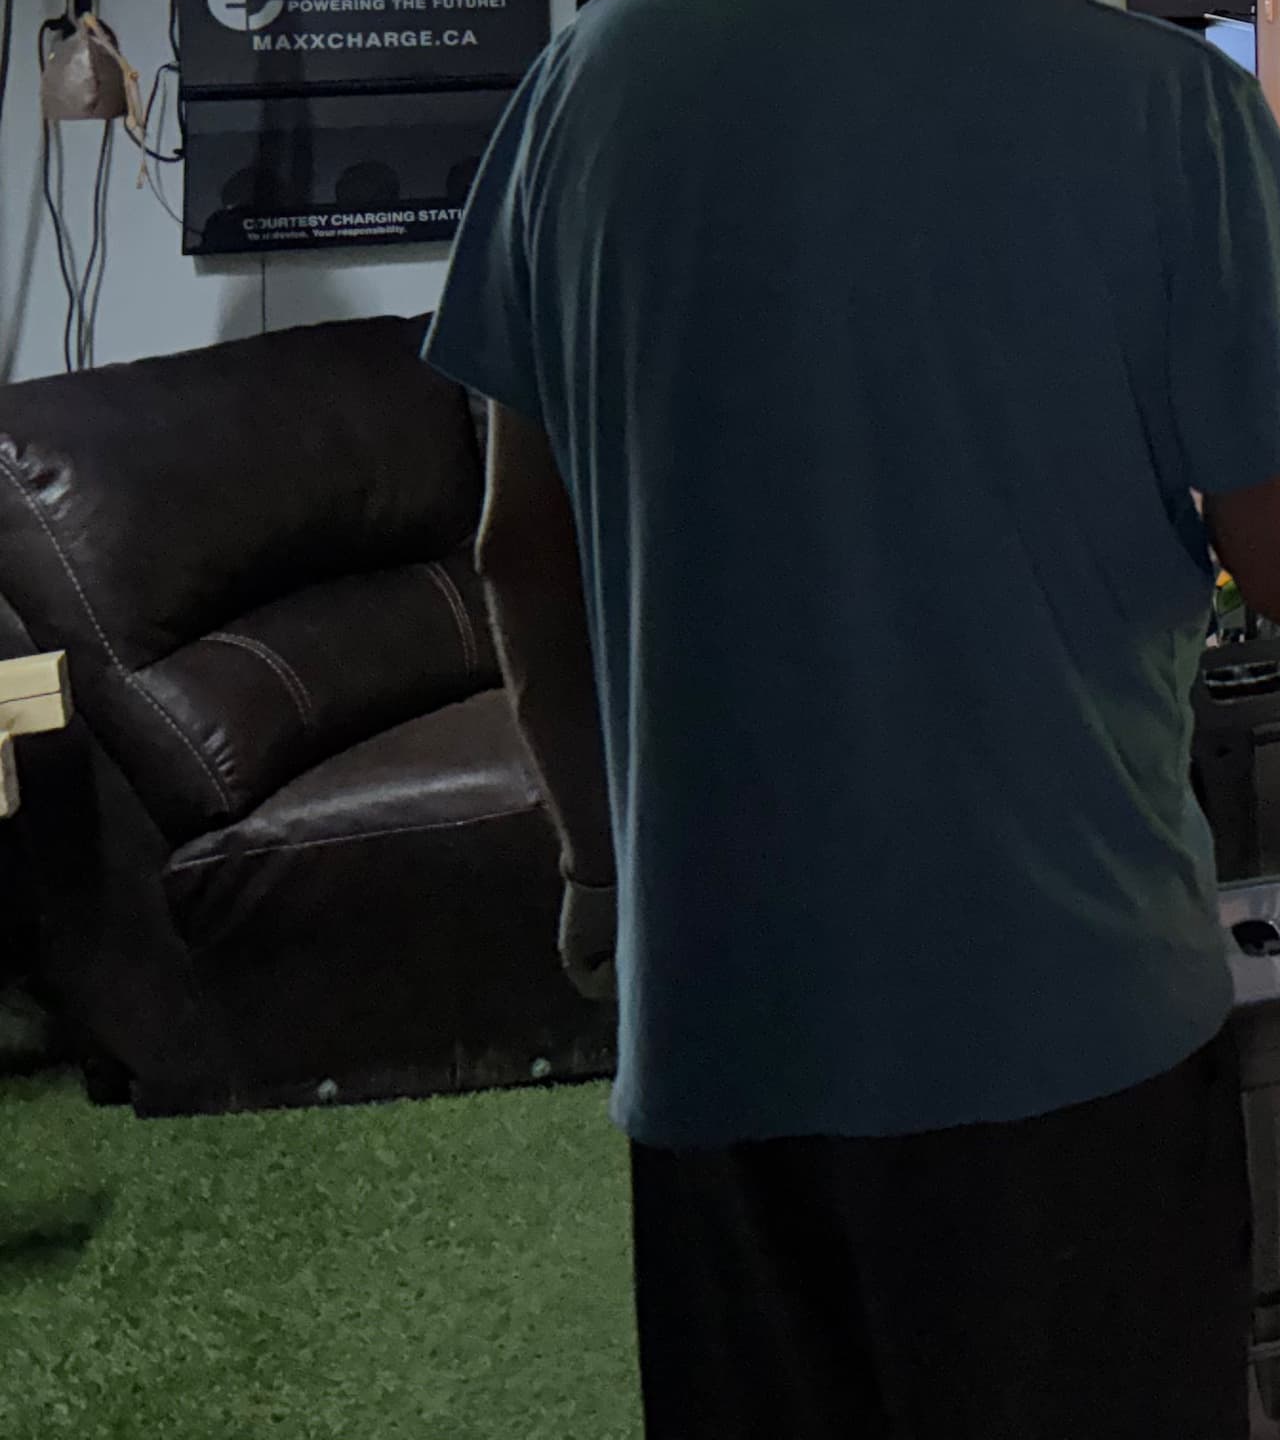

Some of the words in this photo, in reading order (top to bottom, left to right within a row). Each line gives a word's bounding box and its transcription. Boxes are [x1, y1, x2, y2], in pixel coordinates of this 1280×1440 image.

[253, 29, 478, 51] MAXXCHARGE.CA
[331, 210, 415, 227] CHARGING
[312, 228, 336, 237] Your
